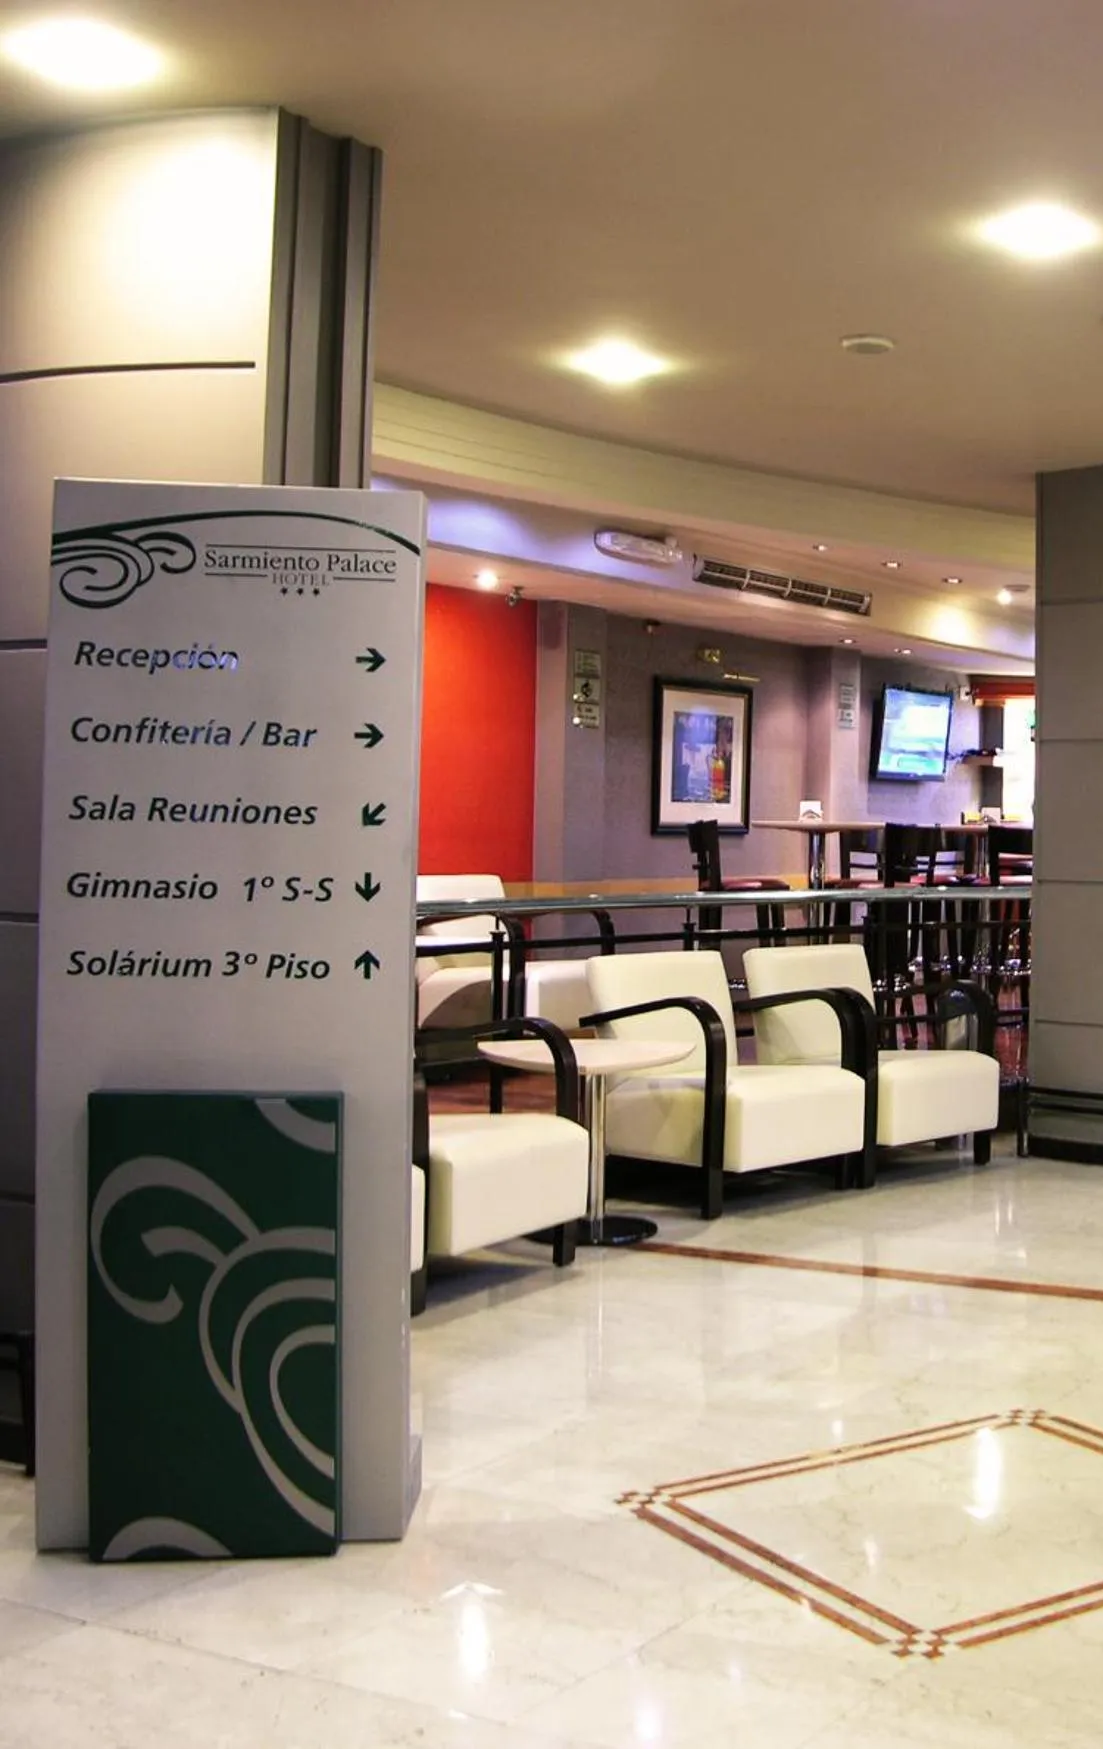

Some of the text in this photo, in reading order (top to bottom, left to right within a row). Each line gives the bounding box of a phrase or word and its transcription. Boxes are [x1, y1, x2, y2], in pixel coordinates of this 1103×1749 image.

[204, 550, 396, 575] Sarmiento Palace
[272, 573, 330, 587] HOTEL
[74, 640, 239, 675] Recepción
[71, 716, 318, 748] Confitería / Bar
[69, 794, 319, 826] Sala Reuniones
[67, 872, 219, 900] Gimnasio
[281, 876, 335, 903] S-S
[67, 950, 212, 979] Solárium
[265, 953, 331, 980] Piso
